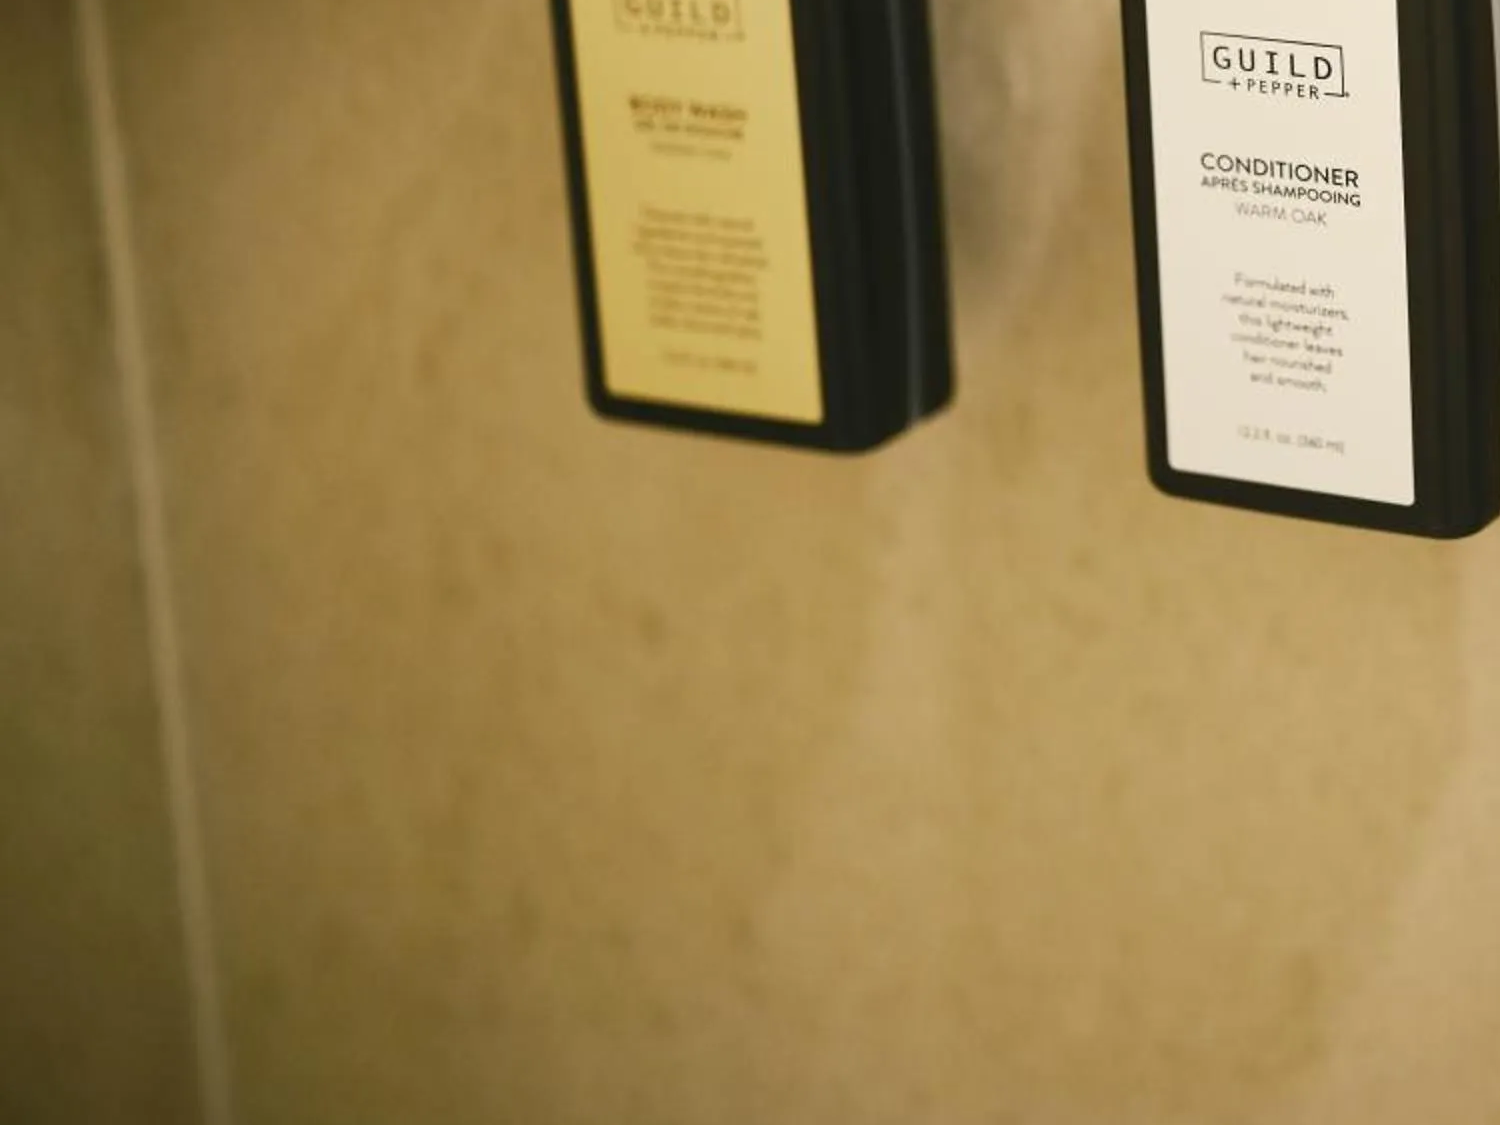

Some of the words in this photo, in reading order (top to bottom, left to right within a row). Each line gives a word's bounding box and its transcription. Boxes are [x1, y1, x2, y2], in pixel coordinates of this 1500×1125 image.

[1212, 45, 1333, 81] GUILD
[1200, 152, 1360, 189] CONDITIONER
[1252, 180, 1362, 208] SHAMPOOING
[1235, 200, 1288, 221] WARM
[1291, 207, 1328, 227] OAK
[1234, 272, 1306, 295] Formulated
[1308, 282, 1335, 299] with
[1266, 313, 1333, 340] lightweight
[1304, 338, 1343, 358] leaves
